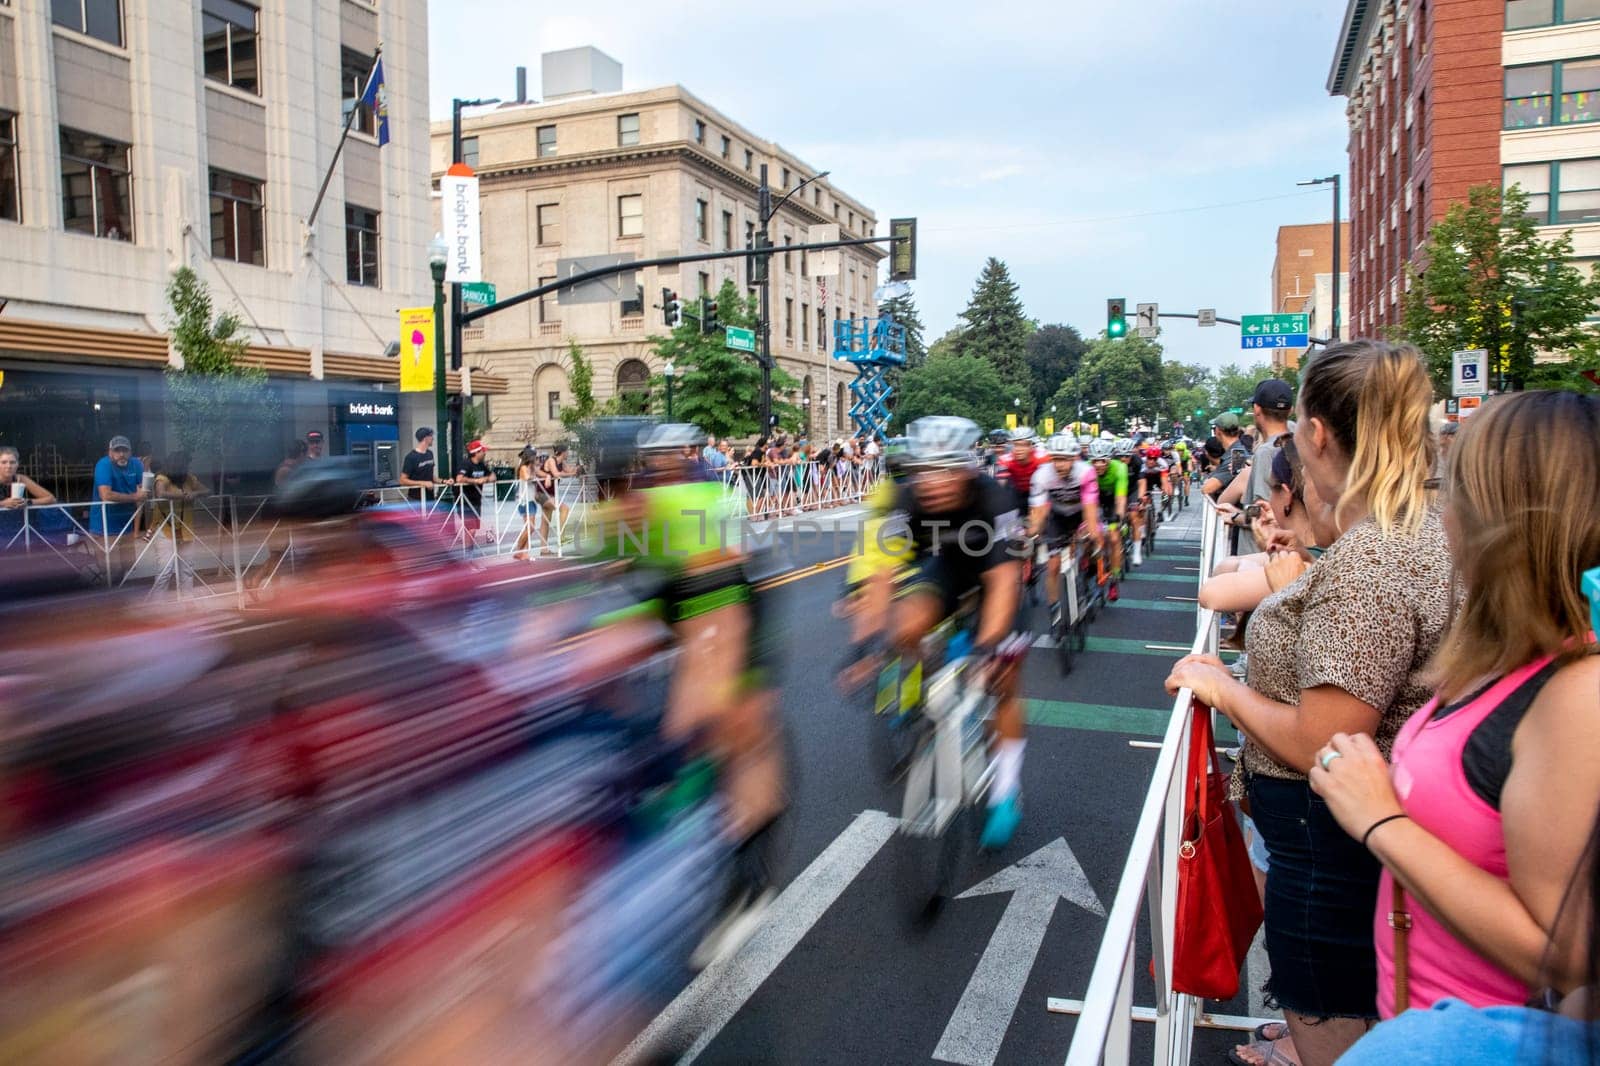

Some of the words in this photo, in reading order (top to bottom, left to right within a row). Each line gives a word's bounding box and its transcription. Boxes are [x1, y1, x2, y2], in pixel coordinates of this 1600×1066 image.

[454, 183, 472, 275] bright.bank
[1262, 323, 1271, 333] N
[1246, 337, 1254, 347] N
